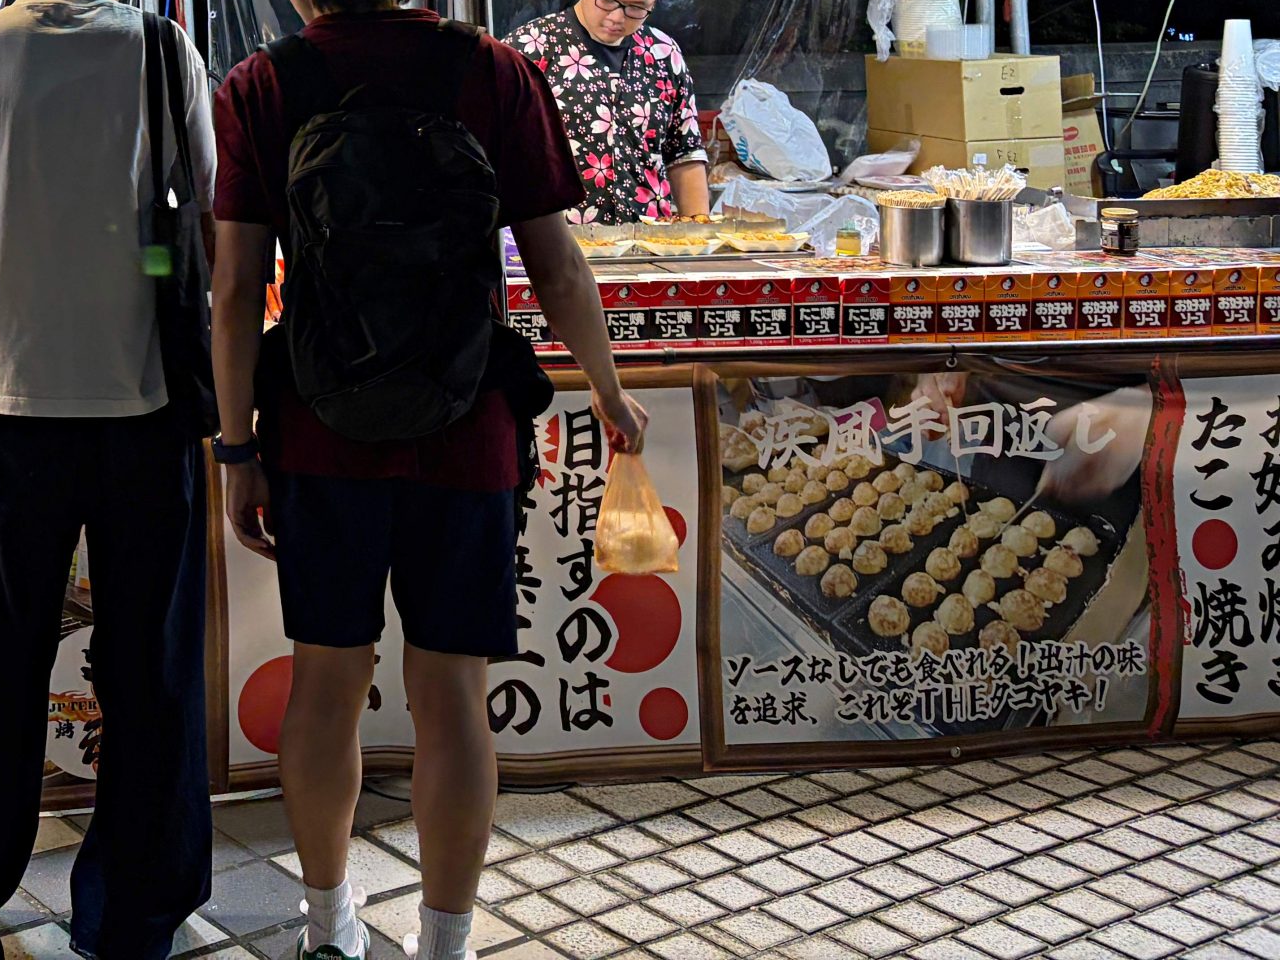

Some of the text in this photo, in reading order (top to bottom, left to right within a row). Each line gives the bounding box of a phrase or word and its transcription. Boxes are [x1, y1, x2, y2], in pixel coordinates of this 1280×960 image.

[1035, 302, 1073, 316] お好み
[1082, 301, 1119, 314] お好み
[1129, 300, 1166, 313] お好み
[1174, 298, 1211, 312] お好み
[1217, 296, 1255, 309] お好み
[894, 306, 933, 319] お好み
[941, 305, 980, 318] お好み
[989, 304, 1028, 318] お好み
[1223, 310, 1249, 323] ソース
[947, 319, 975, 331] ソース
[995, 318, 1022, 330] ソース
[1040, 316, 1067, 328] ソース
[1087, 314, 1113, 327] ソース
[1134, 313, 1161, 326] ソース
[1180, 312, 1206, 325] ソース
[614, 326, 640, 339] ソース
[661, 325, 687, 338] ソース
[709, 324, 735, 337] ソース
[756, 322, 781, 335] ソース
[805, 321, 830, 334] ソース
[854, 322, 880, 334] ソース
[899, 320, 927, 333] ソース
[749, 394, 1117, 470] 疾風手回返し
[1189, 397, 1255, 705] たこ 焼き
